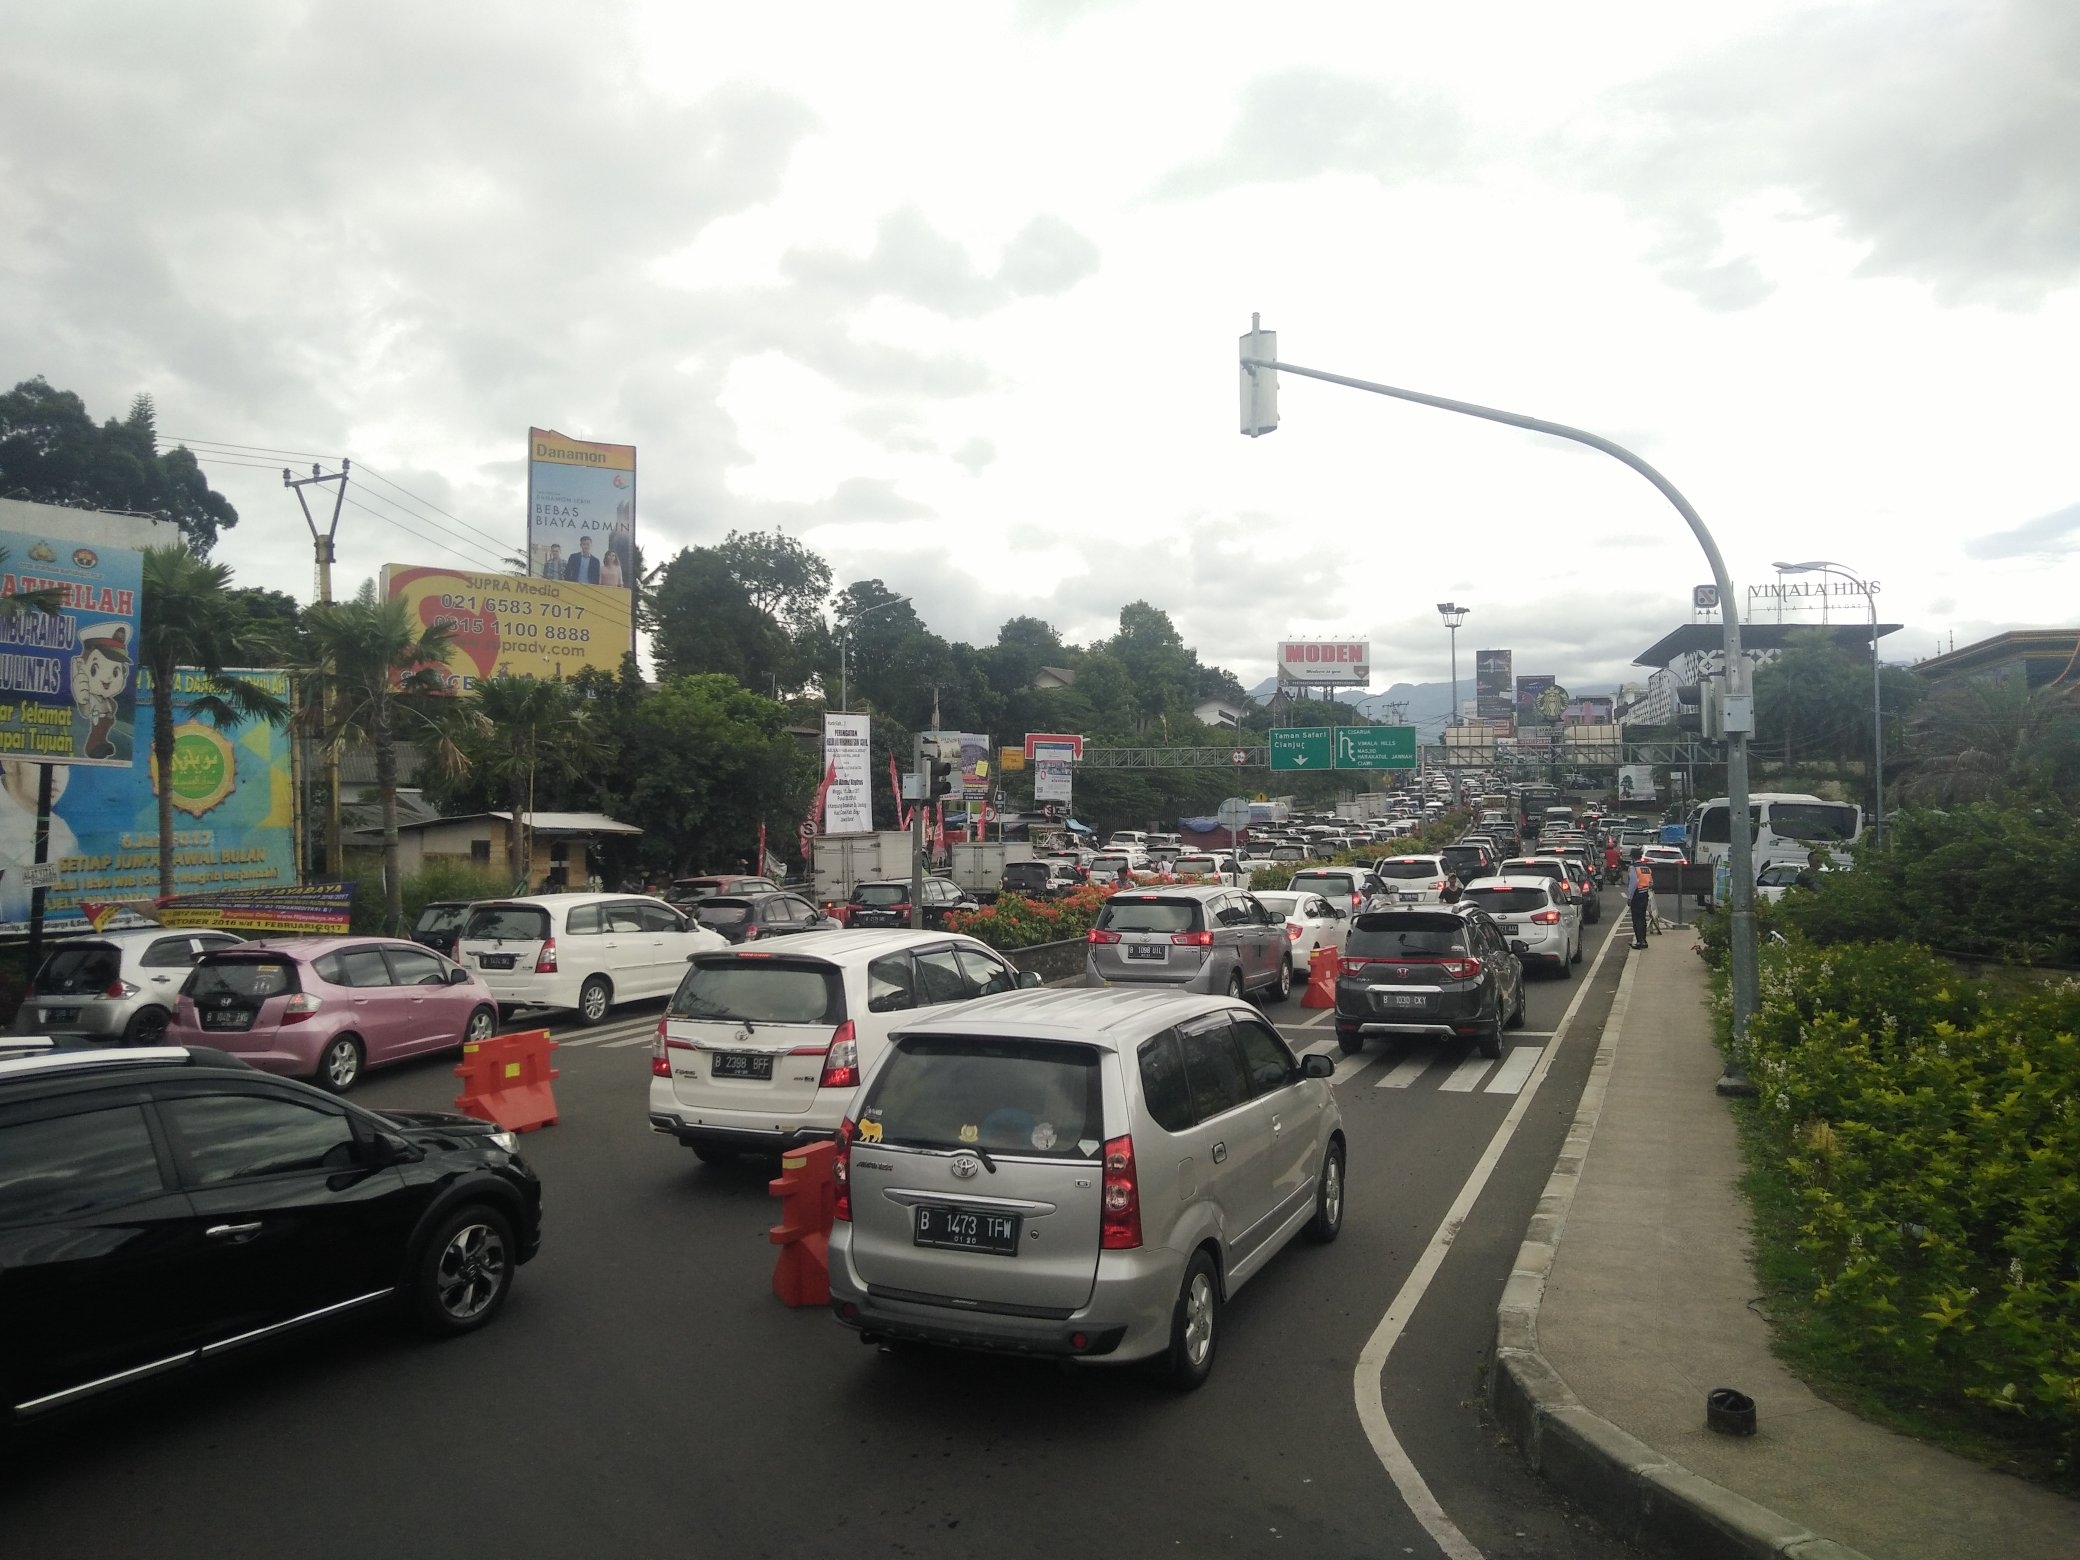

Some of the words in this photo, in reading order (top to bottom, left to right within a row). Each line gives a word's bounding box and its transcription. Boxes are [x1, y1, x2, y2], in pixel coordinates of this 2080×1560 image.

[536, 443, 607, 464] Danamon
[536, 504, 579, 517] BEBAS
[536, 516, 576, 528] BIAYA
[581, 521, 630, 532] ADMIN
[465, 577, 511, 593] SUPRA
[516, 583, 560, 598] Media
[1750, 582, 1827, 603] VIMALA
[1834, 581, 1881, 595] HILLS
[440, 594, 476, 609] 021
[485, 598, 533, 616] 6583
[541, 603, 585, 620] 7017
[492, 621, 538, 638] 1100
[545, 625, 590, 643] 8888
[1285, 644, 1363, 663] MODEN
[21, 699, 72, 726] Selamat
[1274, 741, 1305, 749] Cianjur
[1302, 731, 1327, 739] Safari
[58, 855, 112, 873] SETIAP
[116, 853, 161, 870] JUM'A
[174, 850, 217, 866] AWAL
[221, 847, 266, 864] BULAN
[165, 918, 209, 926] OKTOBER
[264, 922, 314, 930] FEBRUARI
[1383, 996, 1388, 1004] B
[715, 1056, 722, 1068] B
[726, 1056, 747, 1069] 2398
[920, 1211, 930, 1230] B
[947, 1214, 977, 1235] 1473
[987, 1217, 1013, 1240] TFW
